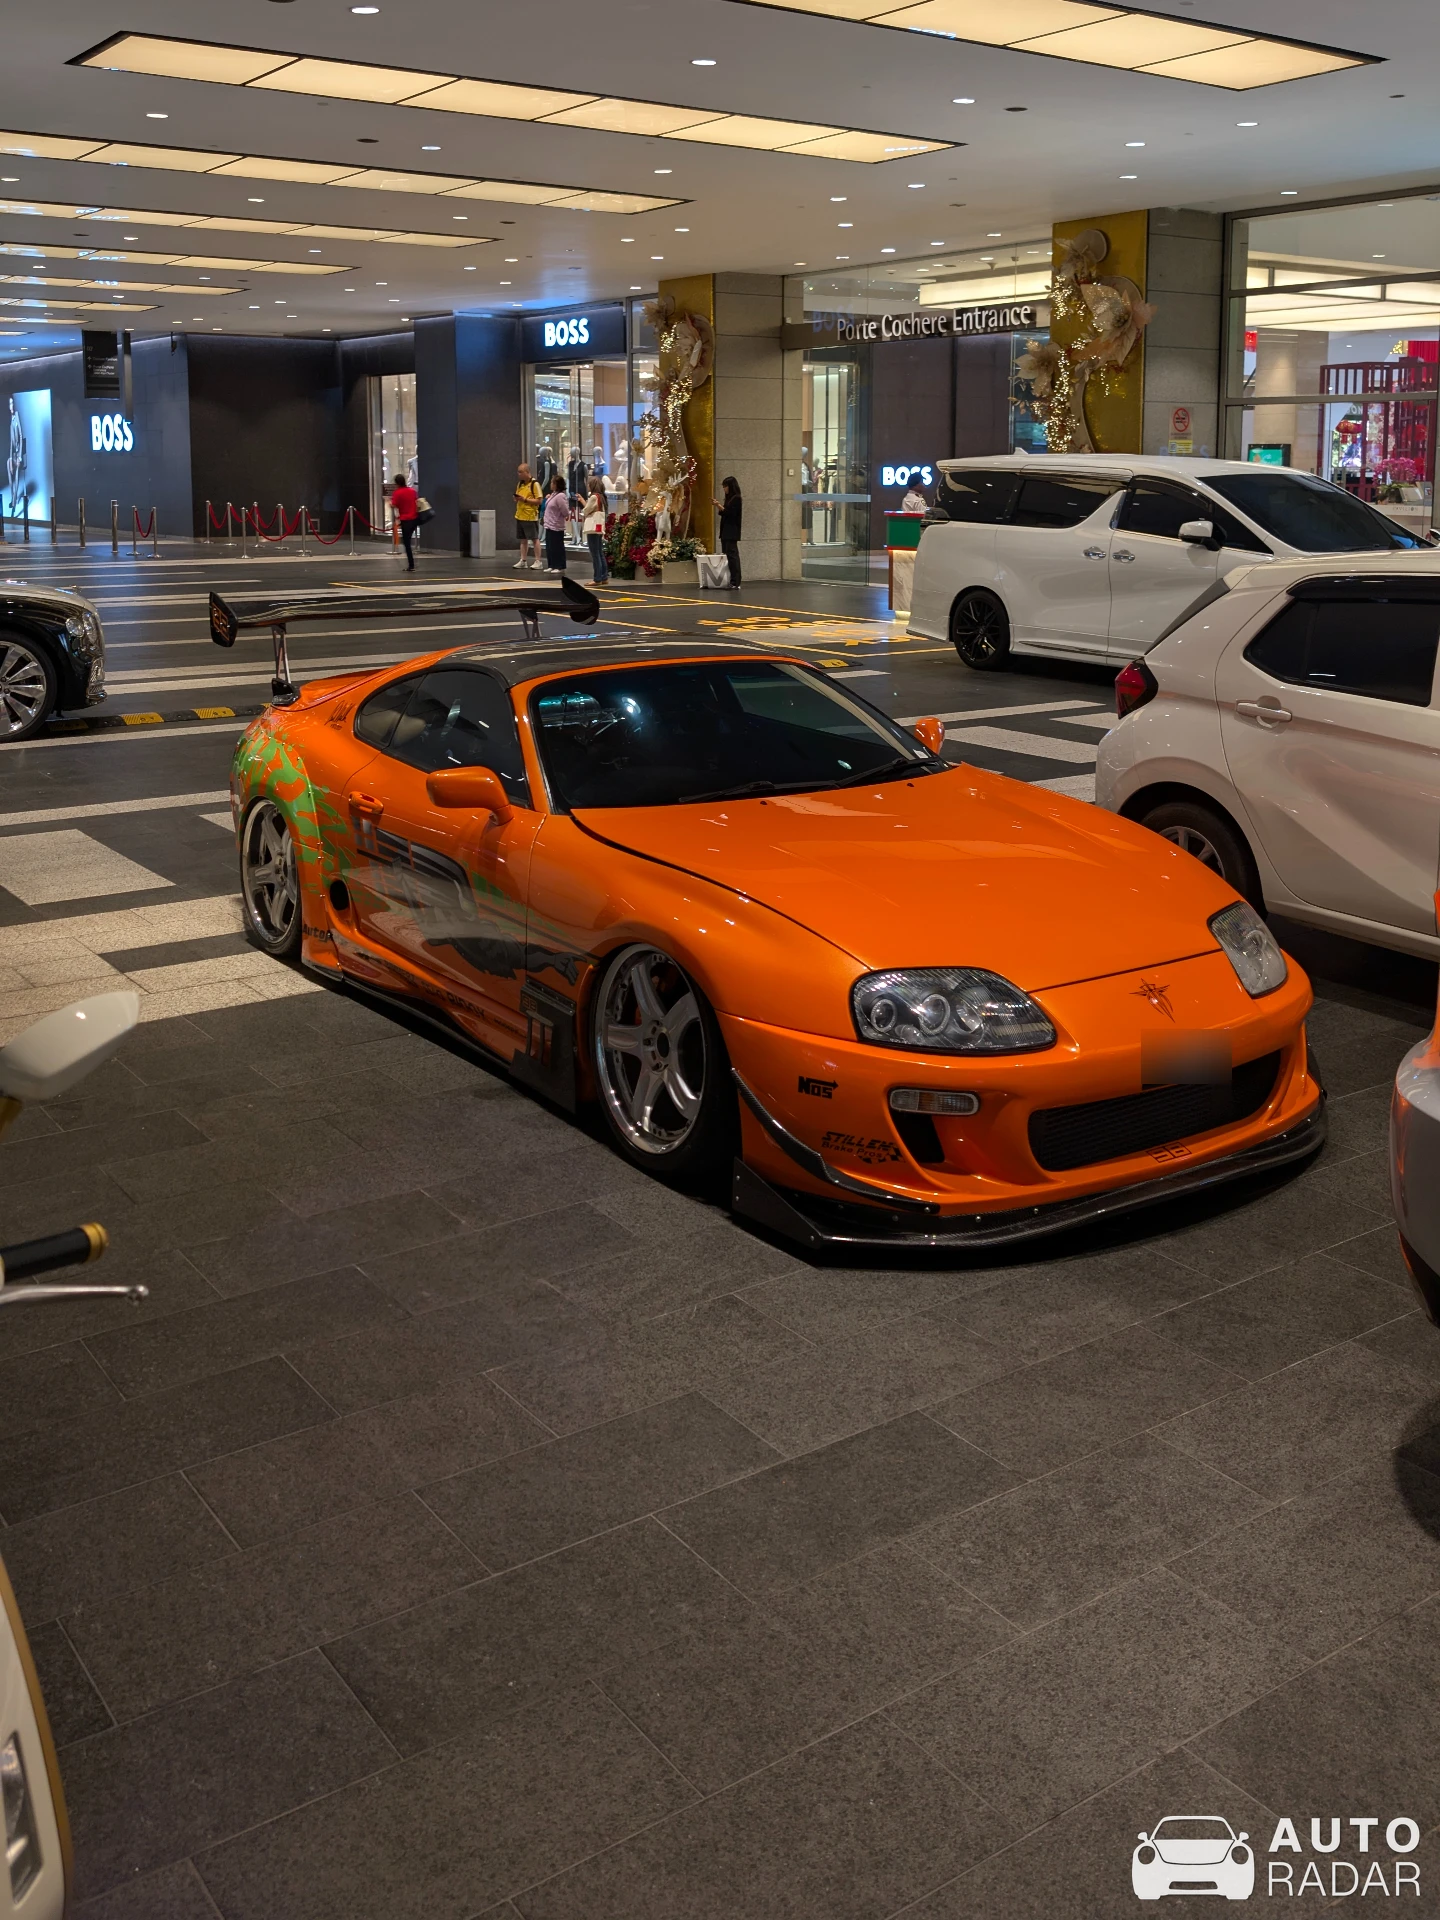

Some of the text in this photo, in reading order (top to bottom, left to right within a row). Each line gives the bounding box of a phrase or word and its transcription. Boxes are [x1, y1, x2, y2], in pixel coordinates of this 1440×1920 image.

[545, 318, 590, 347] BOSS
[837, 305, 1032, 341] Porte Cochere Entrance
[91, 413, 134, 452] BOSS
[798, 1076, 837, 1099] NOS
[821, 1141, 882, 1159] Brake Pros
